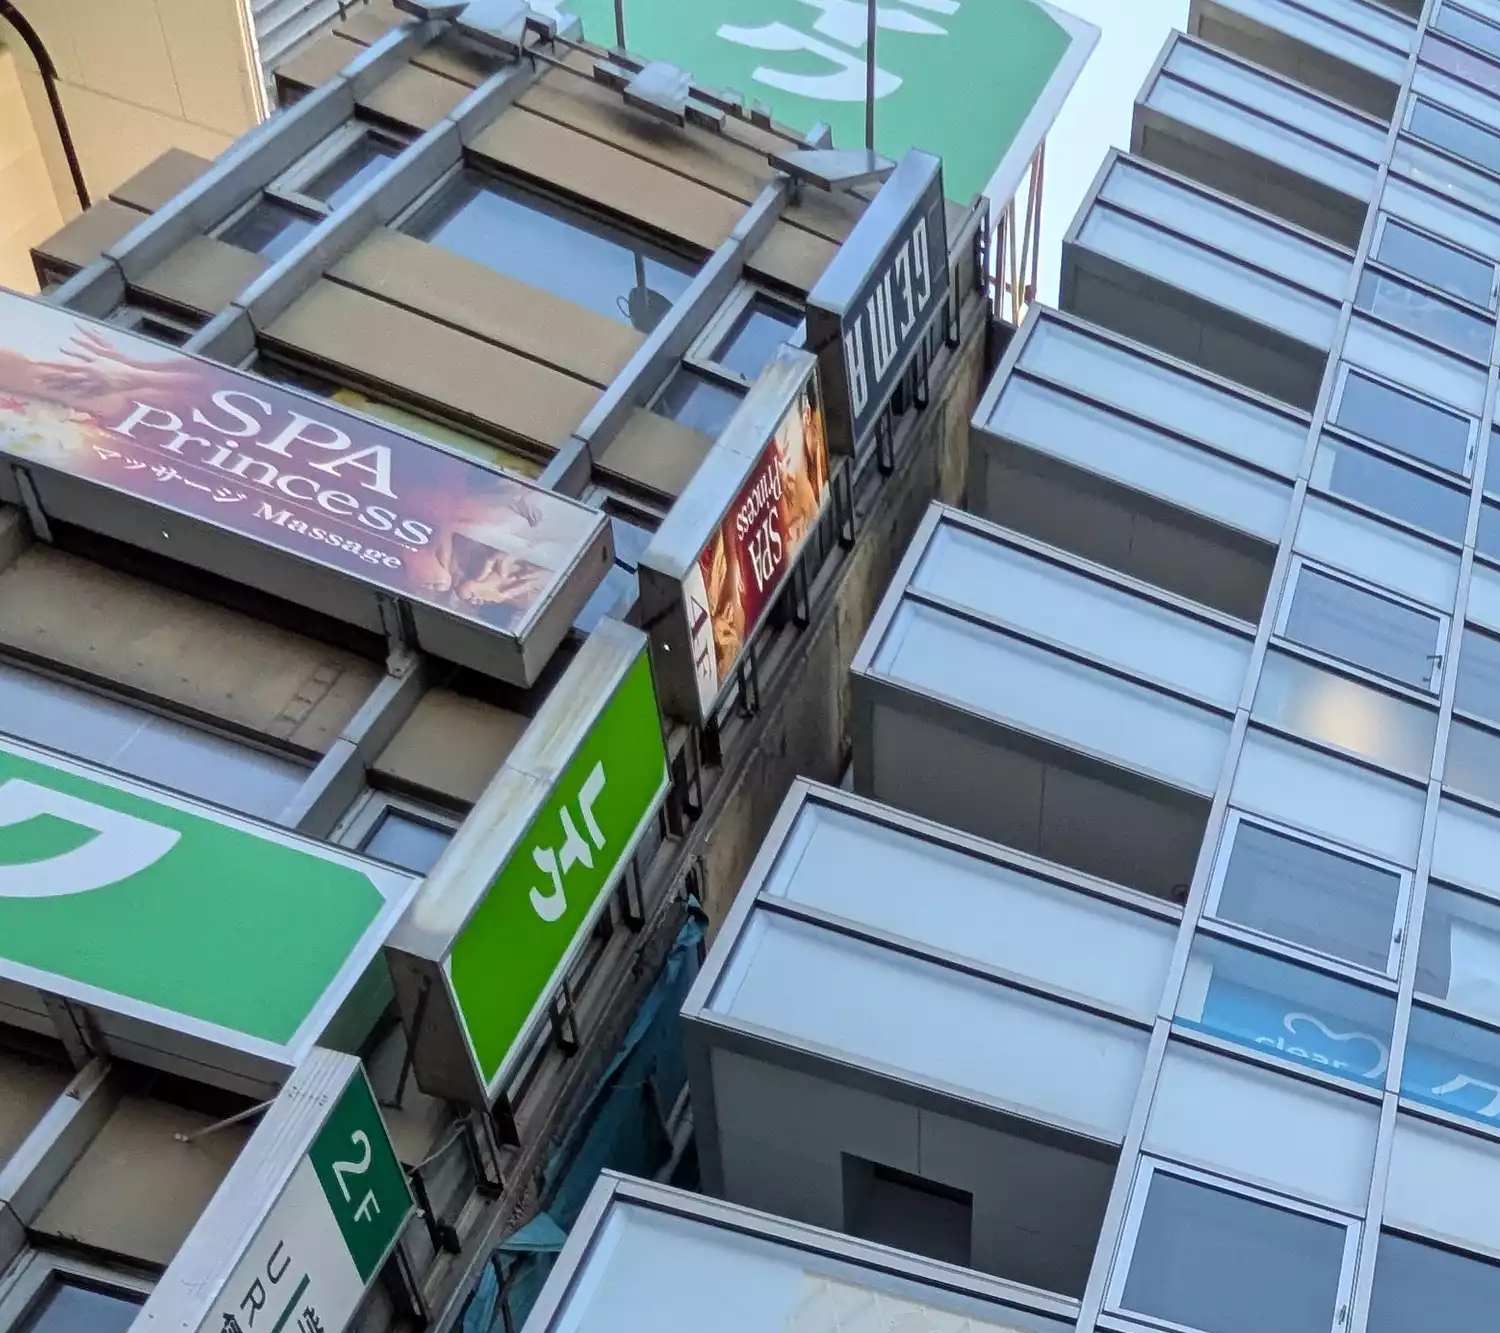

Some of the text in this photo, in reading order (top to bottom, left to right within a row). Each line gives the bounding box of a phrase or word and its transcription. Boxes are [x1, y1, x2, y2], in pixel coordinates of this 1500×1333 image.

[107, 401, 435, 546] Princess
[193, 389, 398, 499] SPA
[736, 455, 784, 542] Princess
[92, 445, 403, 571] マッサージ Massage
[747, 507, 783, 594] SPA
[529, 761, 607, 923] レイク
[332, 1128, 381, 1225] 2F
